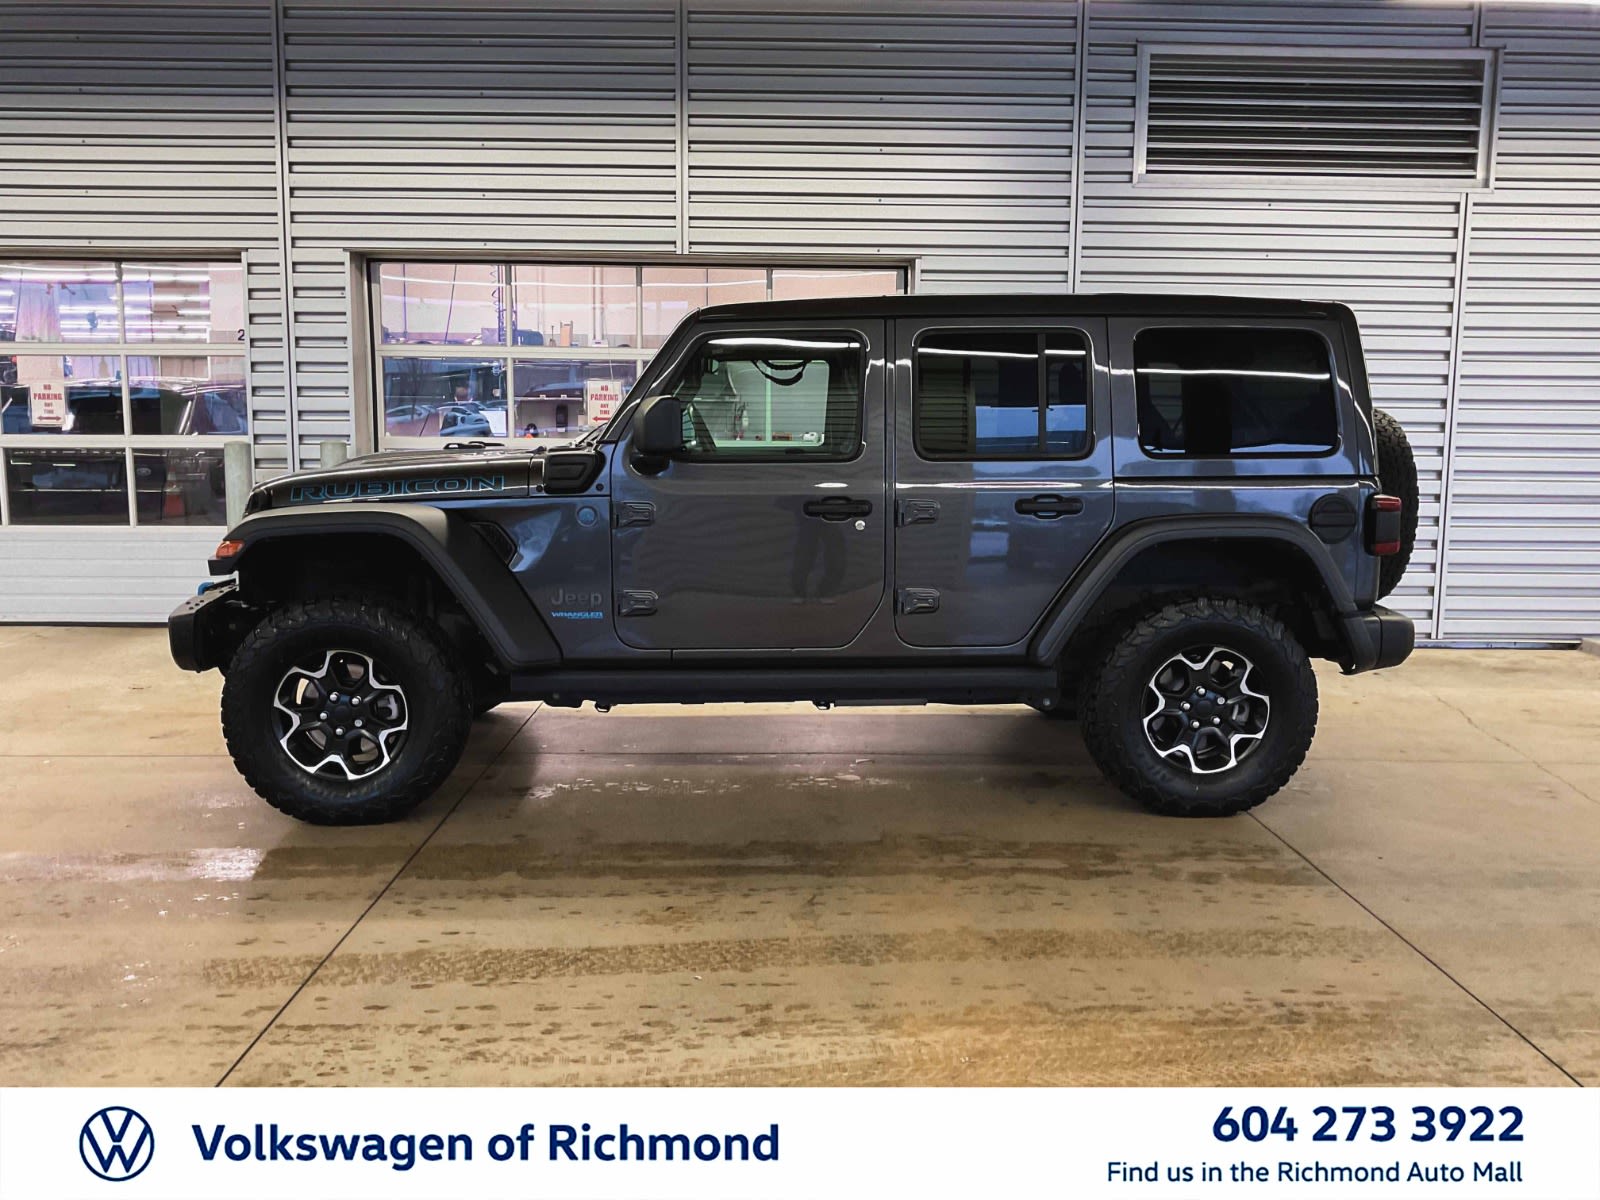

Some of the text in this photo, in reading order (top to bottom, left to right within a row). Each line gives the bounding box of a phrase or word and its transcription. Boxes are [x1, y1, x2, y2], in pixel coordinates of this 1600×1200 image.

[237, 328, 245, 341] 2
[33, 392, 63, 401] PARKING
[590, 393, 619, 401] PARKING
[290, 475, 505, 501] RUBICON
[551, 588, 602, 609] Jeep
[551, 611, 604, 619] WRANGLER
